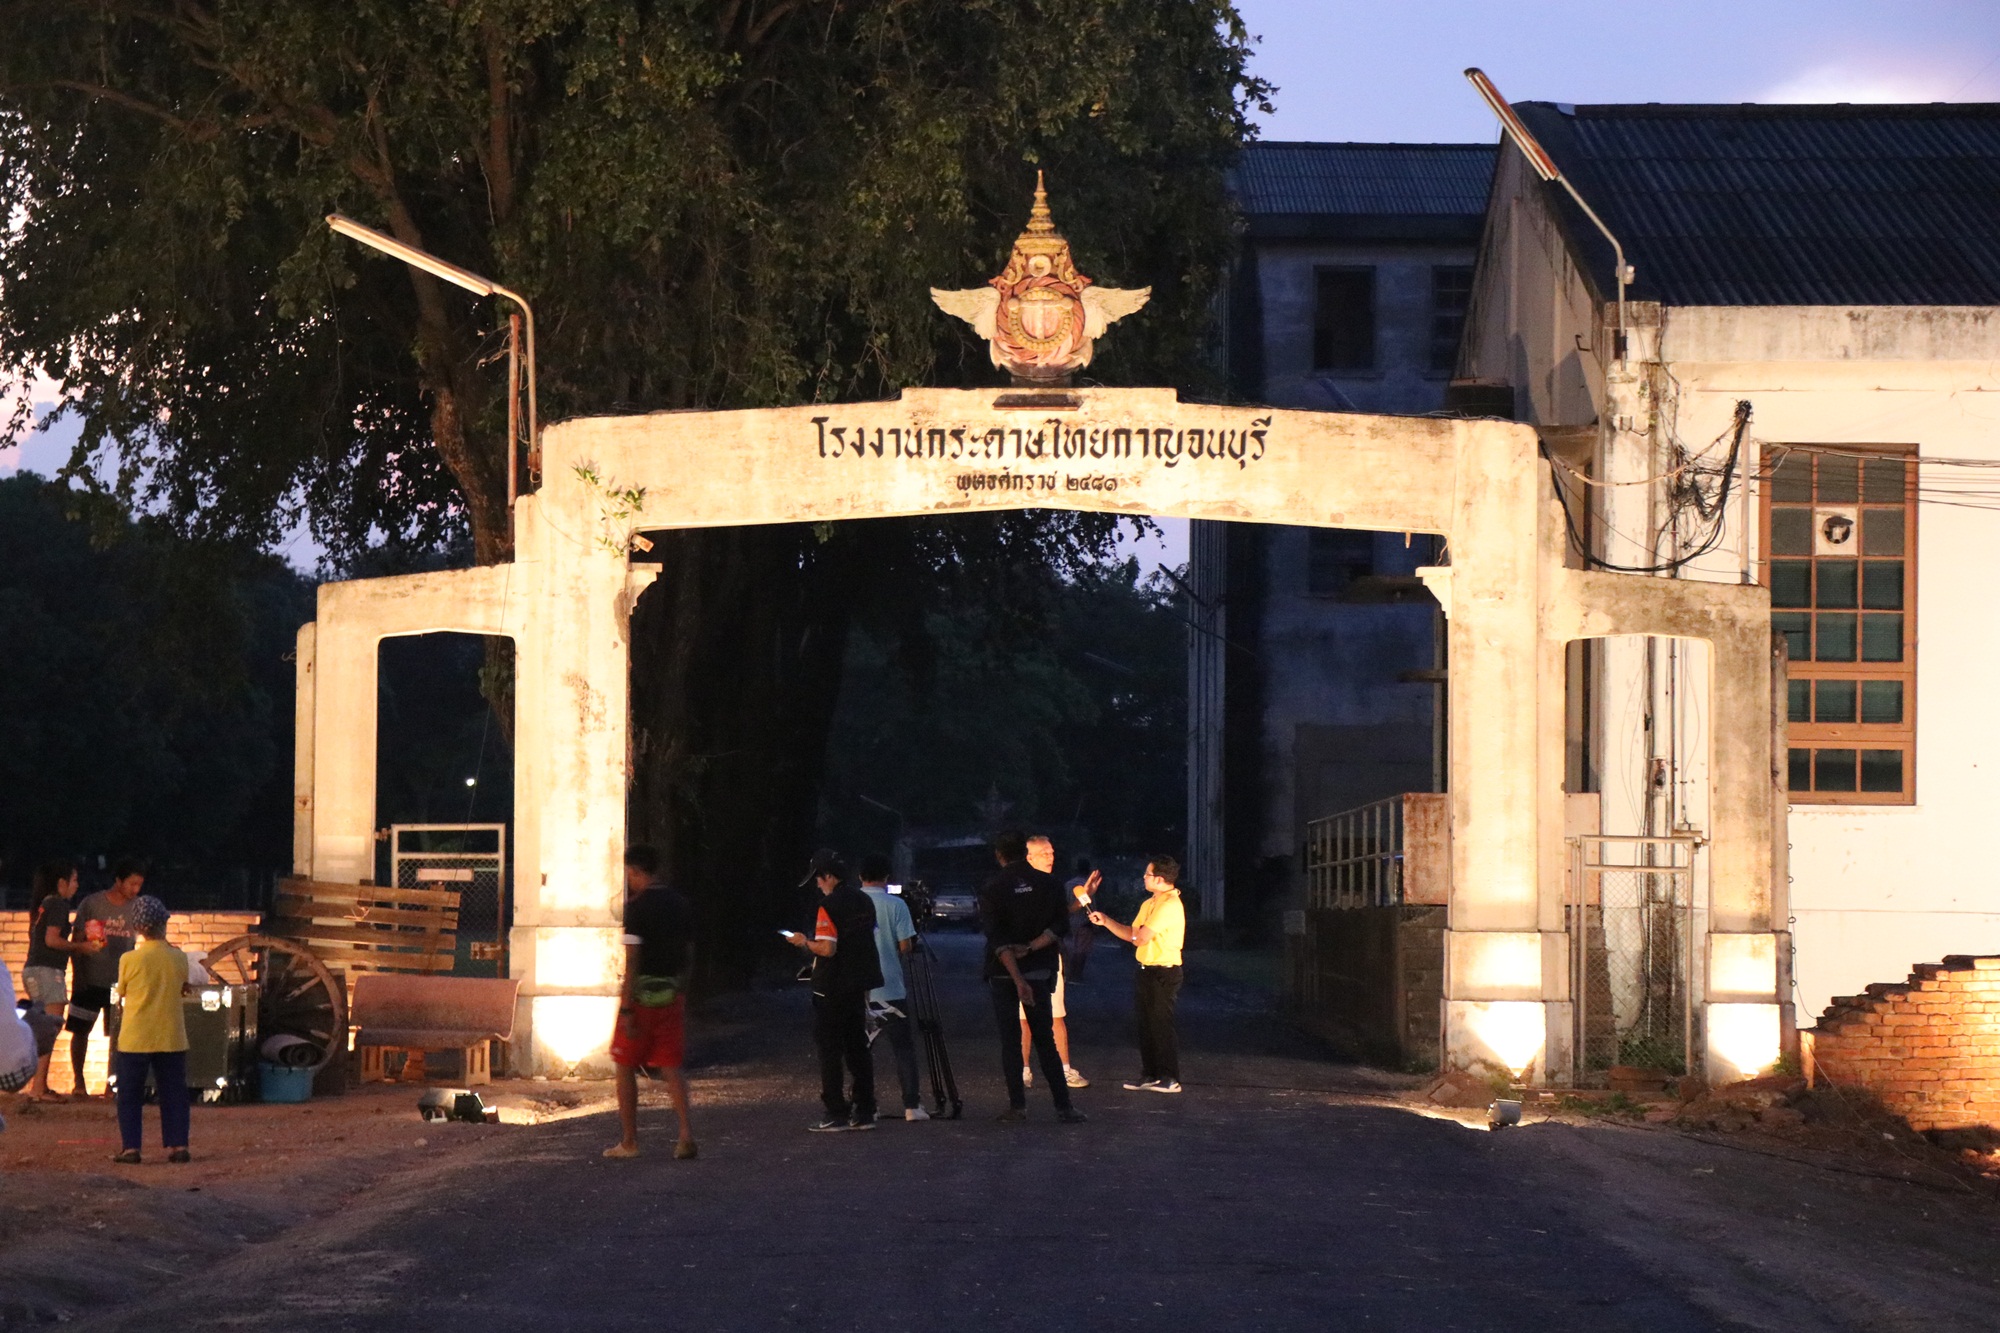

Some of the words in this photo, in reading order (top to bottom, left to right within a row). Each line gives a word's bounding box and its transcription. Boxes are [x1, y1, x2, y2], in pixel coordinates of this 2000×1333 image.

[810, 415, 1272, 470] โรงงานกระดาษไทยกาญจนบุรี
[1066, 473, 1118, 491] ๒๔๘๑
